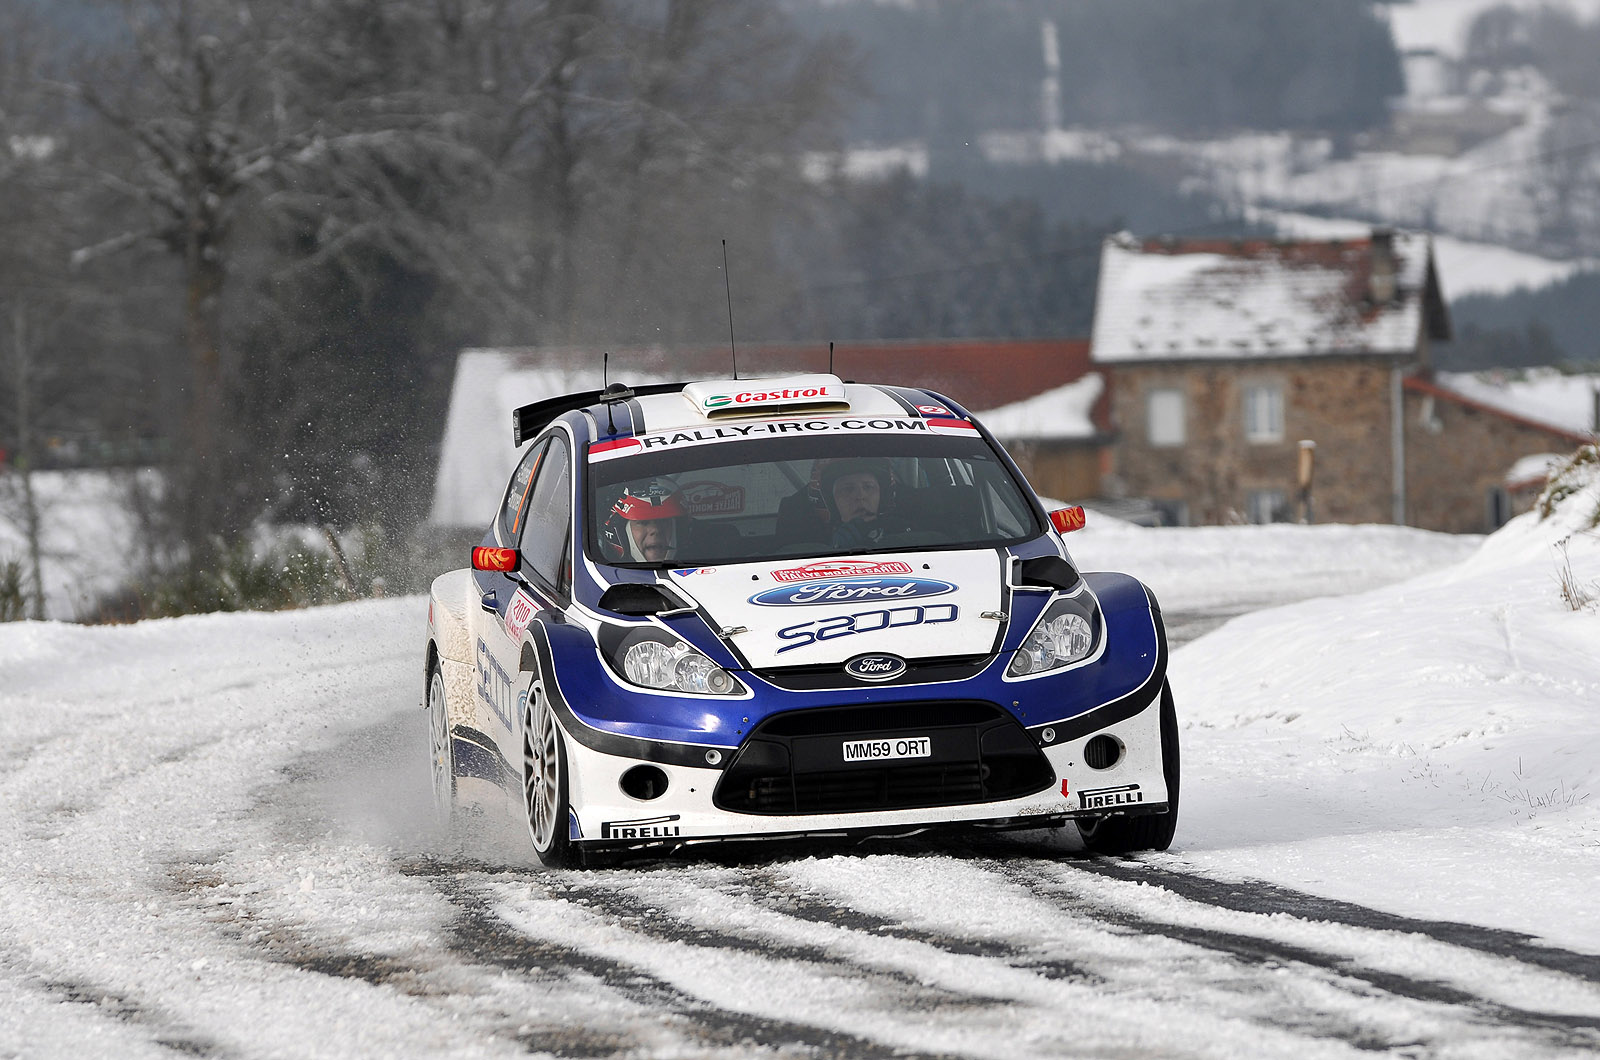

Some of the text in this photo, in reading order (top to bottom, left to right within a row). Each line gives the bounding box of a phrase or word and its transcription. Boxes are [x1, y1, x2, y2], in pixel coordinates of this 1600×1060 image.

[735, 386, 829, 403] Castrol
[643, 419, 926, 448] RALLY-IRC.COM
[1058, 506, 1084, 528] IRC
[780, 571, 821, 581] RALLYE
[789, 579, 917, 603] Ford
[513, 599, 531, 623] 2010
[775, 604, 960, 654] S2000
[859, 657, 893, 673] Ford
[845, 740, 928, 759] MM59 ORT
[1076, 783, 1143, 809] PIRELLI
[601, 814, 681, 839] PIRELLI
